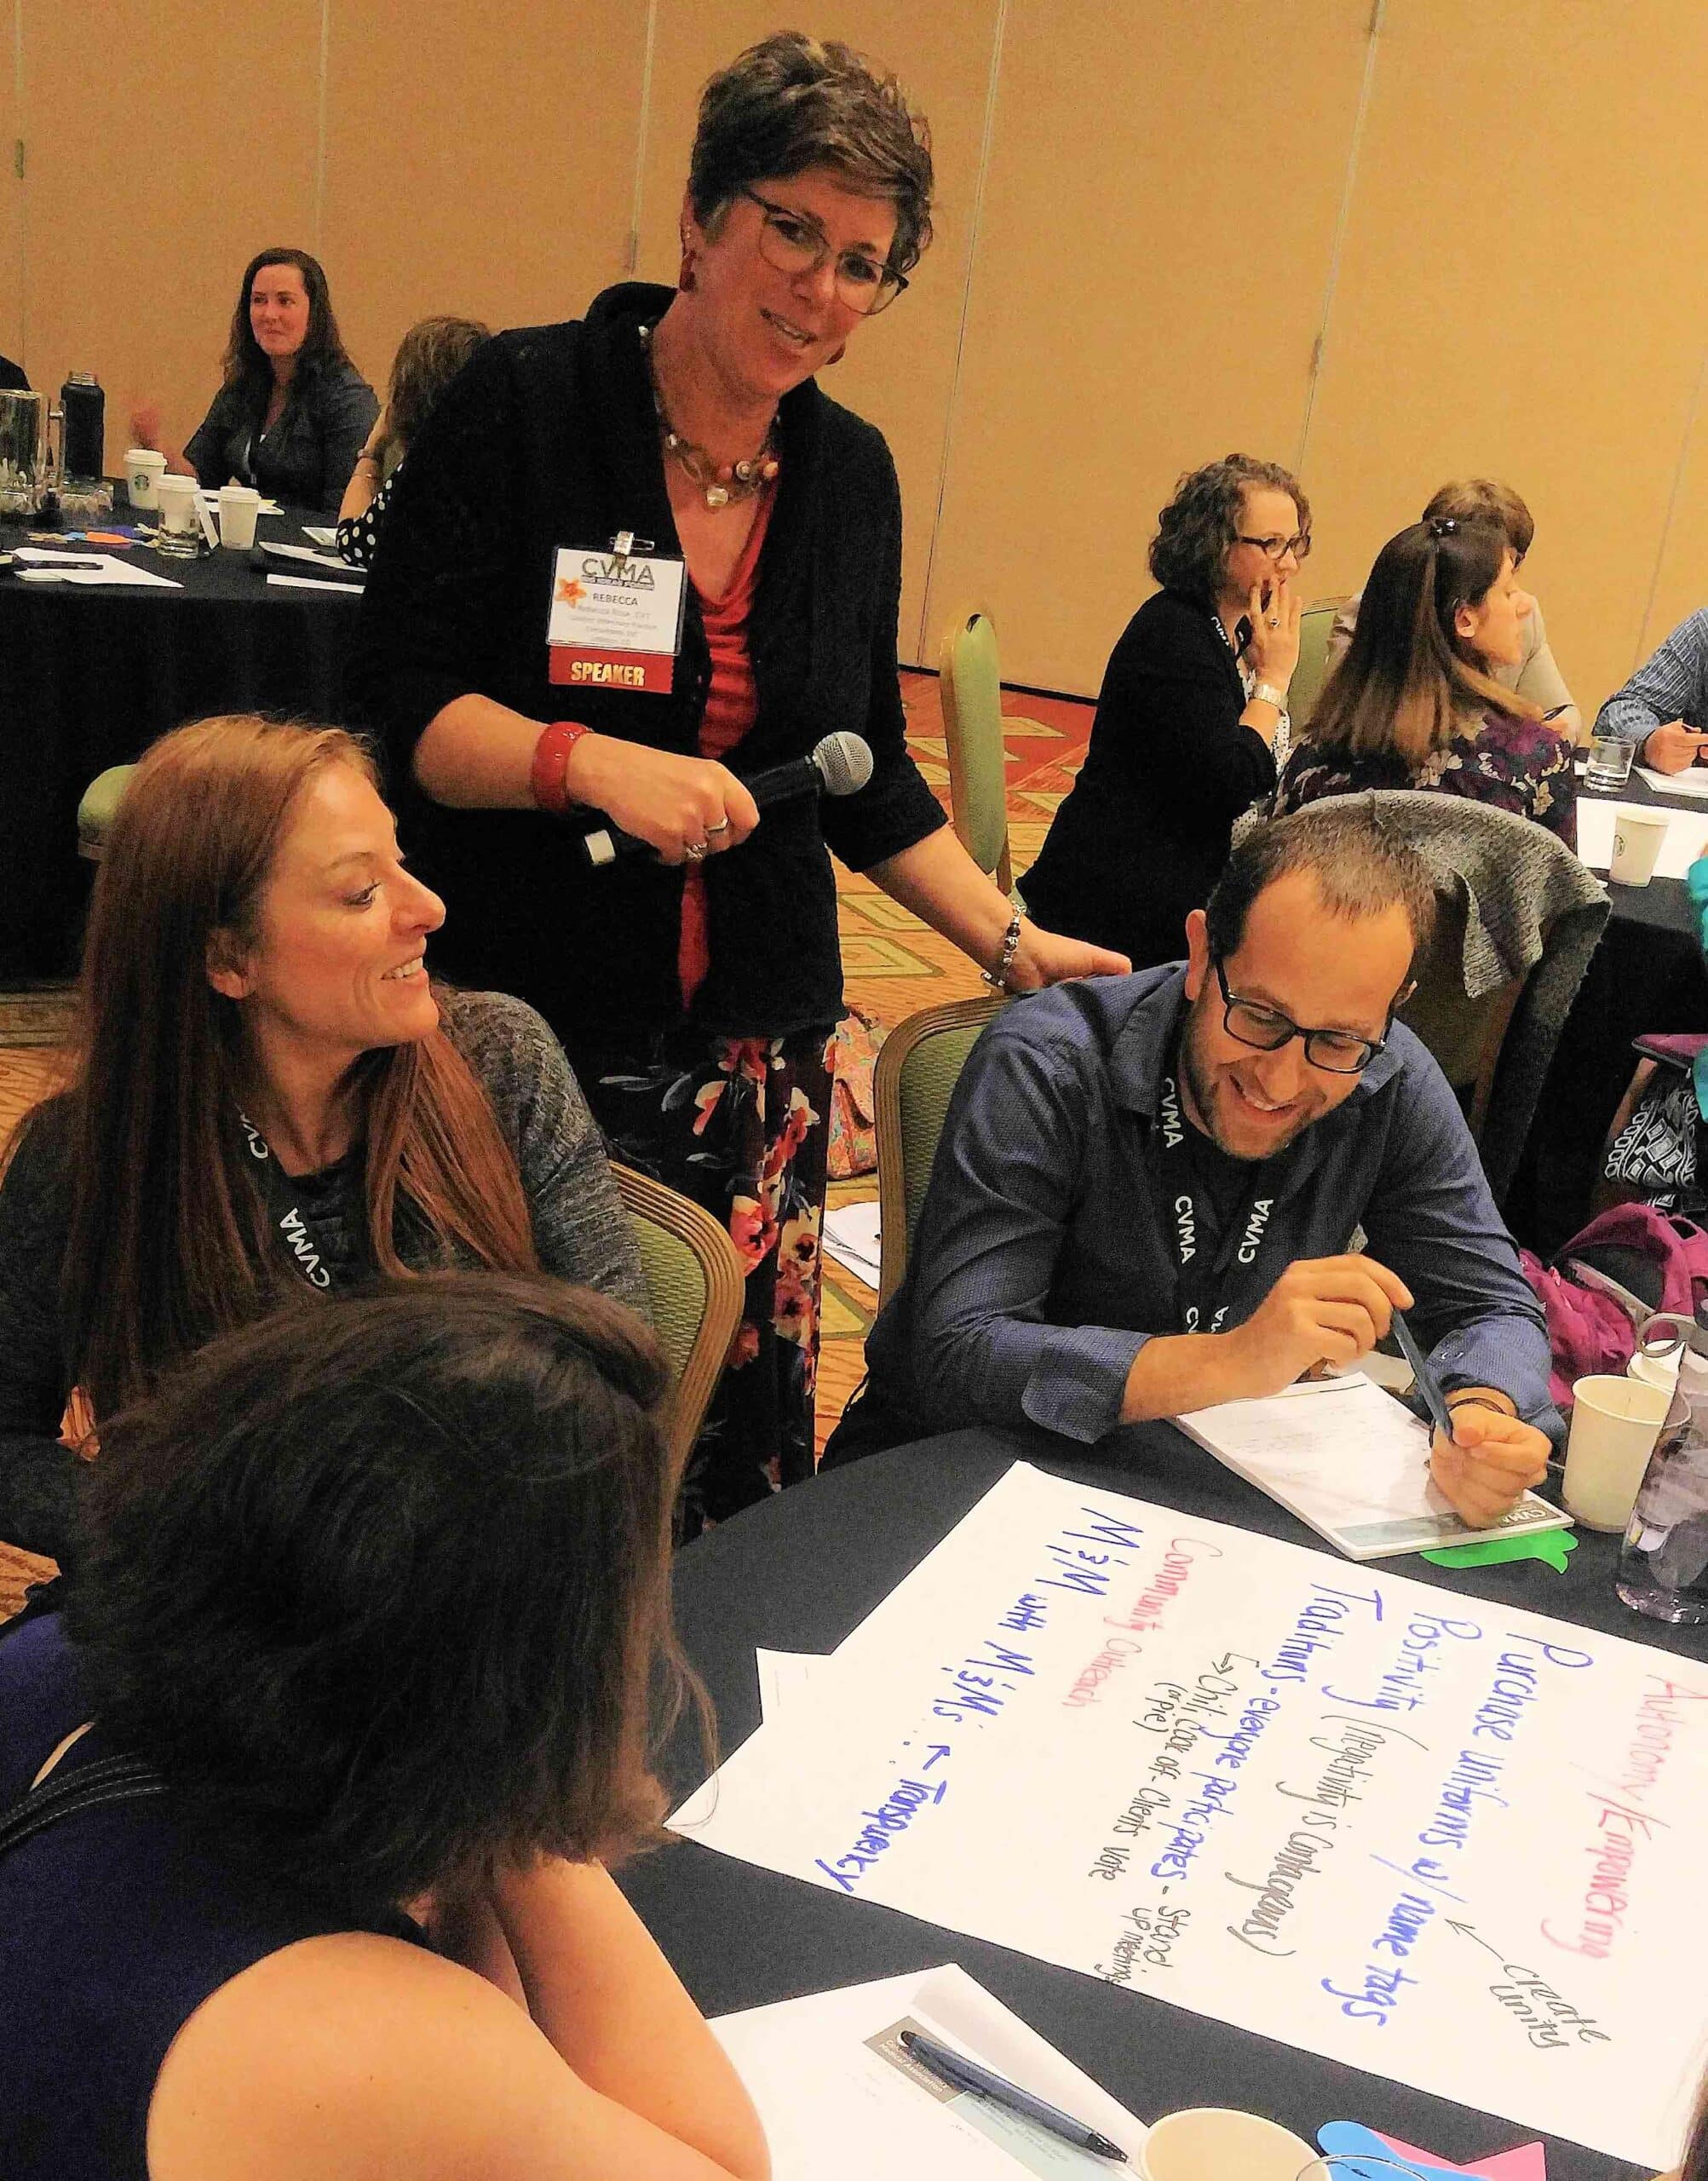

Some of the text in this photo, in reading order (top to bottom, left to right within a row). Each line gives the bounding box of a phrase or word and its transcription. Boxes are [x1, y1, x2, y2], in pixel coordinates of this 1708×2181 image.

[582, 558, 654, 586] CVMA
[592, 592, 638, 606] REBECCA
[571, 661, 645, 687] SPEAKER
[279, 1207, 330, 1287] CVMA
[1175, 1195, 1195, 1264] CVMA
[1238, 1199, 1274, 1263] CVMA
[1062, 1538, 1223, 1708] Community Outreach
[1321, 1613, 1482, 1712] Positivity
[1472, 1632, 1594, 1741] Purchase
[1199, 1696, 1281, 1770] everyone
[1369, 1853, 1468, 1903] w/
[1372, 1892, 1436, 1957] name
[1320, 1963, 1420, 2027] tags
